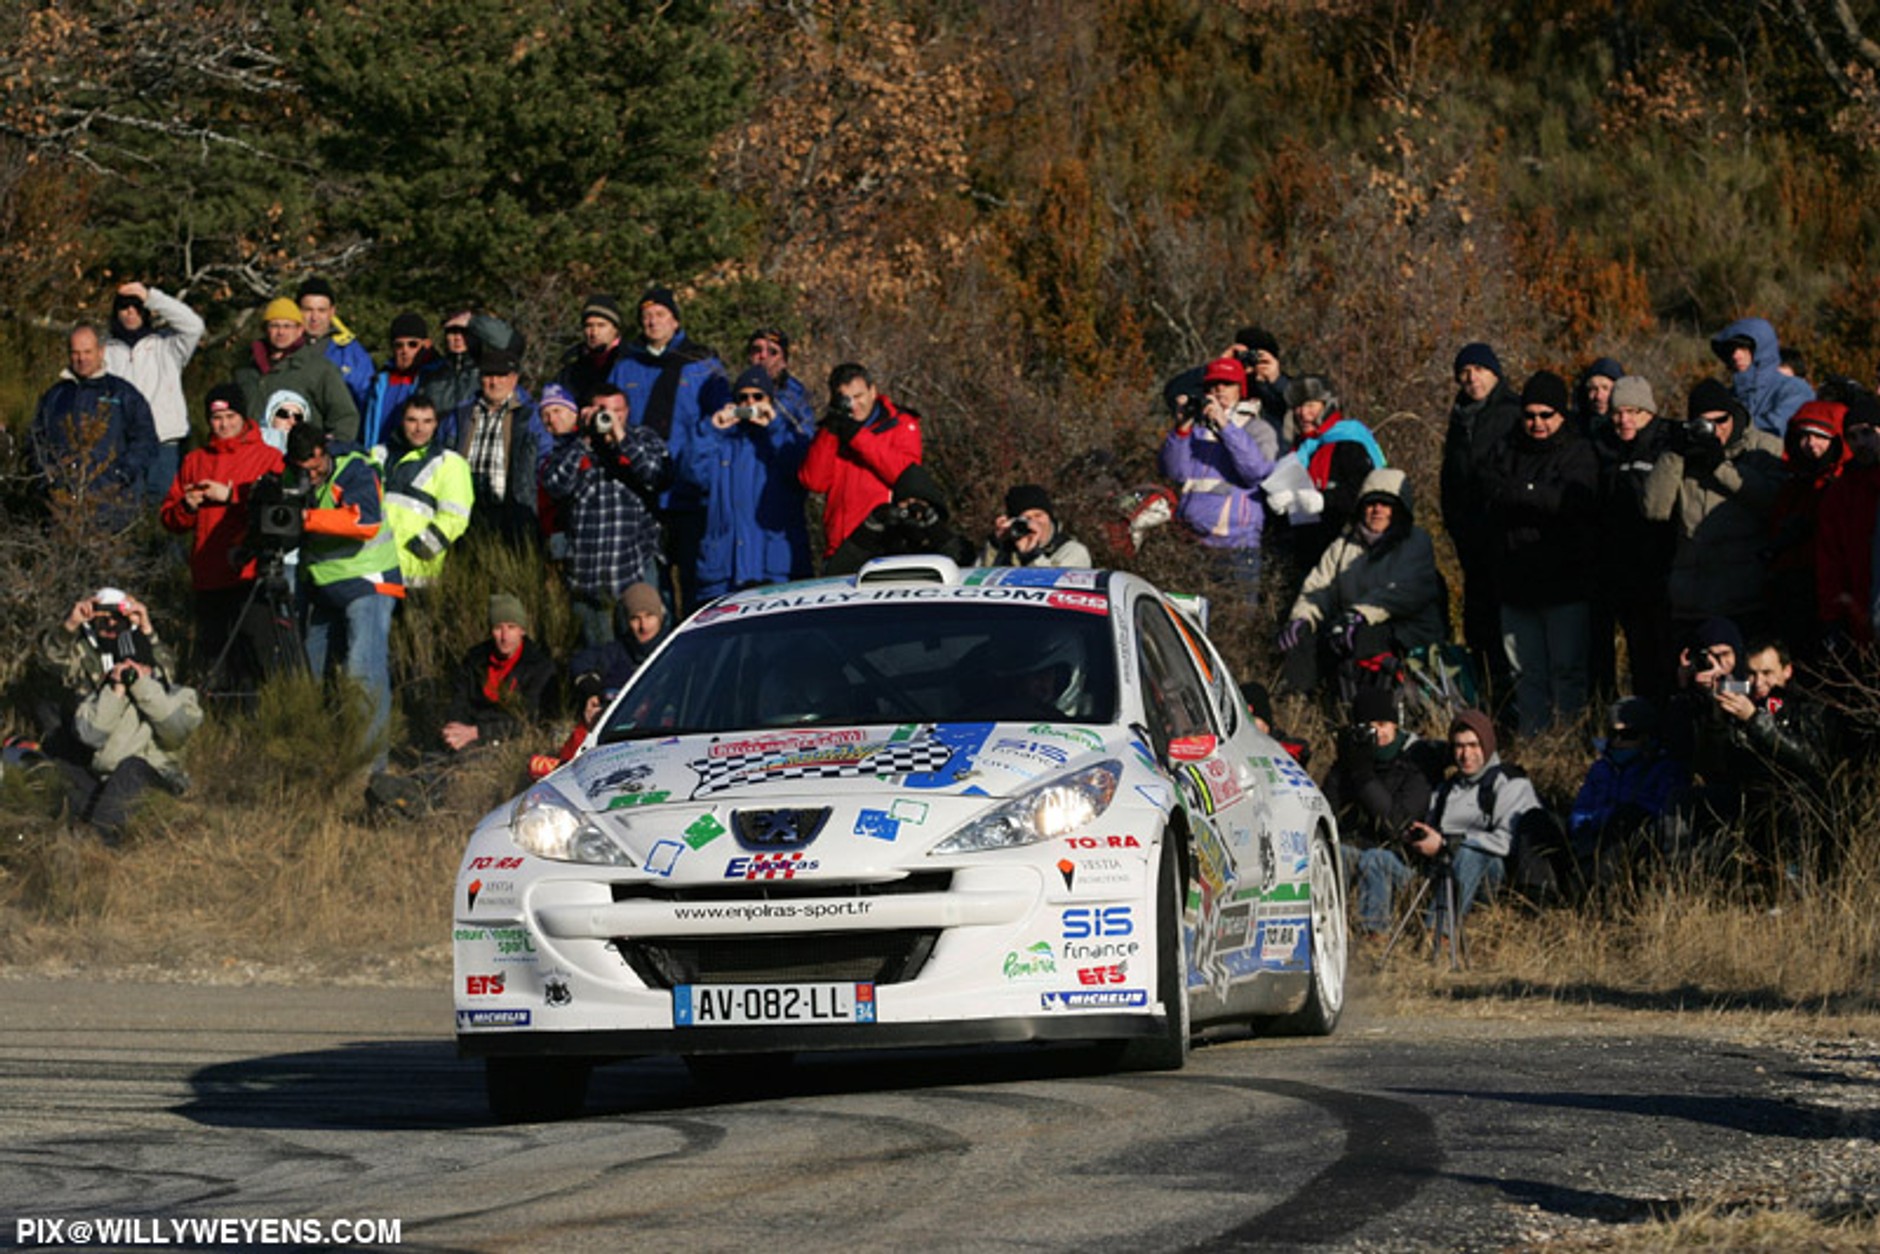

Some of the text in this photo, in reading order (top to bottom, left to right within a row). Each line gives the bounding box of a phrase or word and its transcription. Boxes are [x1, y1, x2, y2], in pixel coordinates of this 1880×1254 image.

[740, 589, 1047, 614] RALLY-IRC.COM
[724, 857, 819, 879] Enjolras
[674, 901, 872, 921] www.enjolras-sport.fr
[1063, 941, 1139, 959] finance
[466, 974, 505, 996] ETS
[1077, 964, 1127, 985] ETS
[698, 987, 848, 1020] AV-082-LL
[1068, 993, 1144, 1005] MICHELIN
